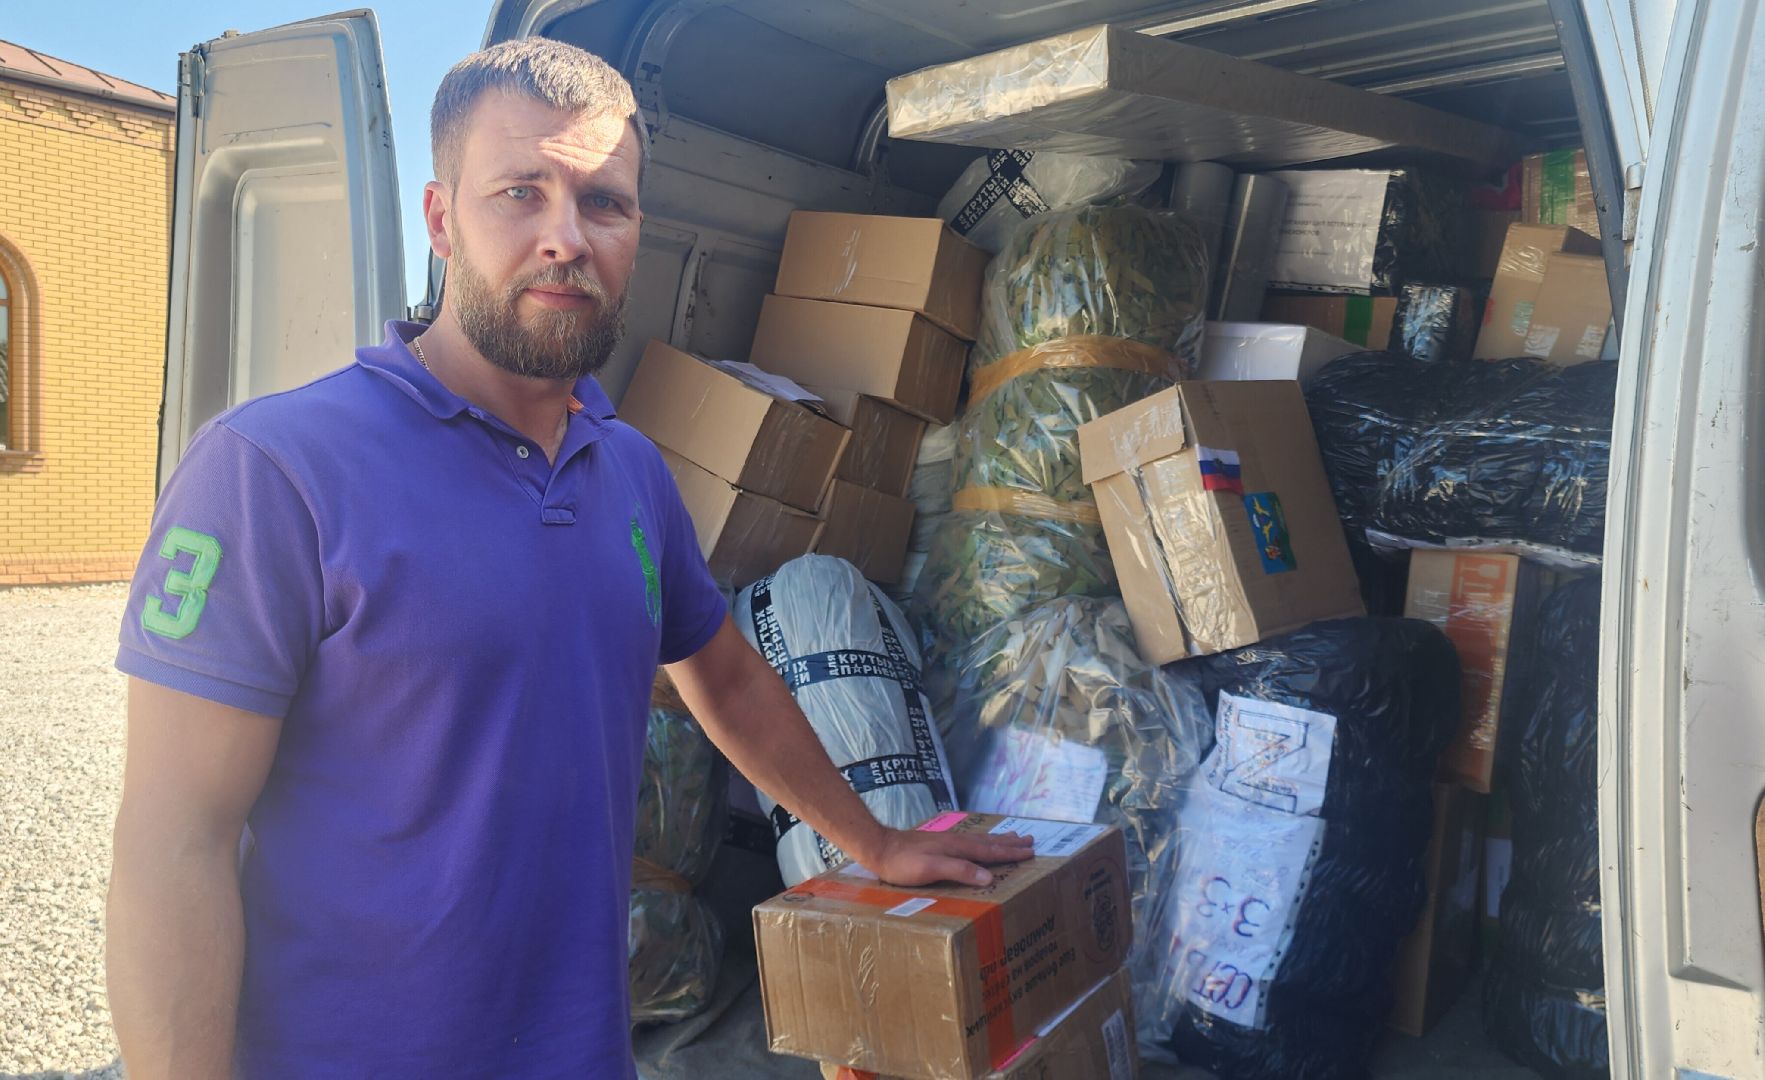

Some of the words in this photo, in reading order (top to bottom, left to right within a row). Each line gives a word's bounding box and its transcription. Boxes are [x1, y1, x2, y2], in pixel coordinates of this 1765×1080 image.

[964, 173, 1004, 217] КРУТЫХ
[141, 527, 223, 640] 3
[827, 654, 840, 676] ДЛЯ
[869, 762, 886, 785] ДЛЯ
[881, 758, 921, 772] КРУТ
